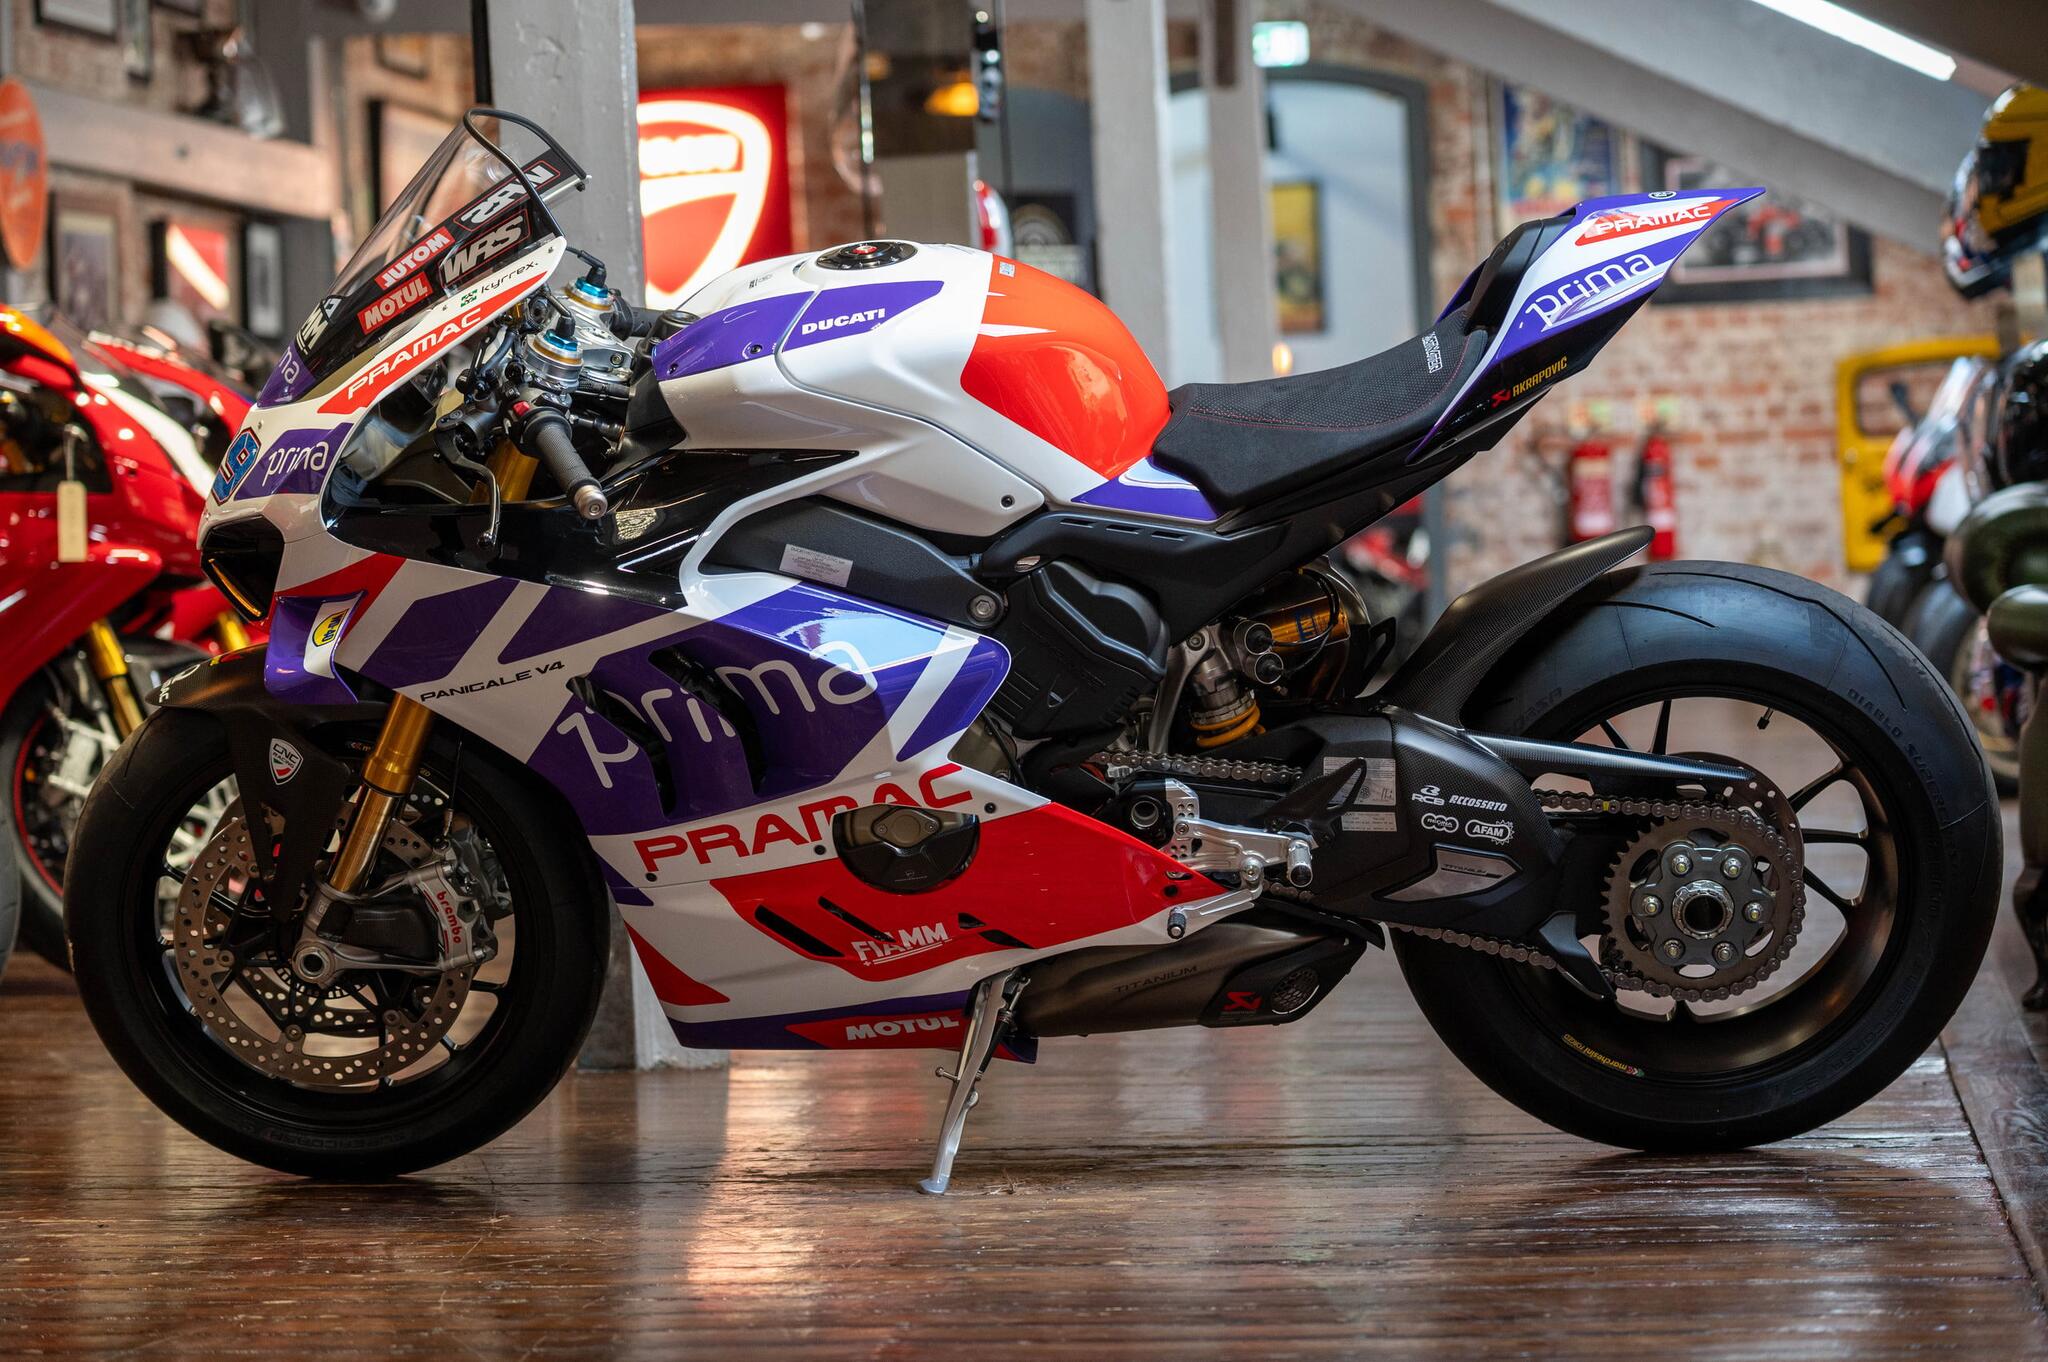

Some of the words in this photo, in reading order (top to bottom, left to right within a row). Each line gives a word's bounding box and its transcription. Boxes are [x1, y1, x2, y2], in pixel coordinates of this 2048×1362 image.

[1596, 206, 1712, 234] PRAMAC
[441, 215, 524, 284] WRS
[363, 278, 428, 330] MOTUL
[1525, 253, 1657, 327] prima
[801, 308, 886, 335] DUCATI
[347, 307, 482, 400] PRAMAC
[420, 669, 533, 702] PANIGALE
[534, 660, 566, 675] V4
[556, 640, 878, 789] prima
[272, 752, 295, 769] RACING
[273, 743, 298, 765] CNC
[1411, 793, 1445, 806] RCB
[1472, 824, 1504, 837] AFAM
[436, 891, 462, 944] brembo
[851, 922, 949, 961] FIAMM
[1113, 965, 1198, 993] TITANIUM
[845, 1016, 960, 1041] MOTUL
[1584, 1046, 1628, 1071] marchesini
